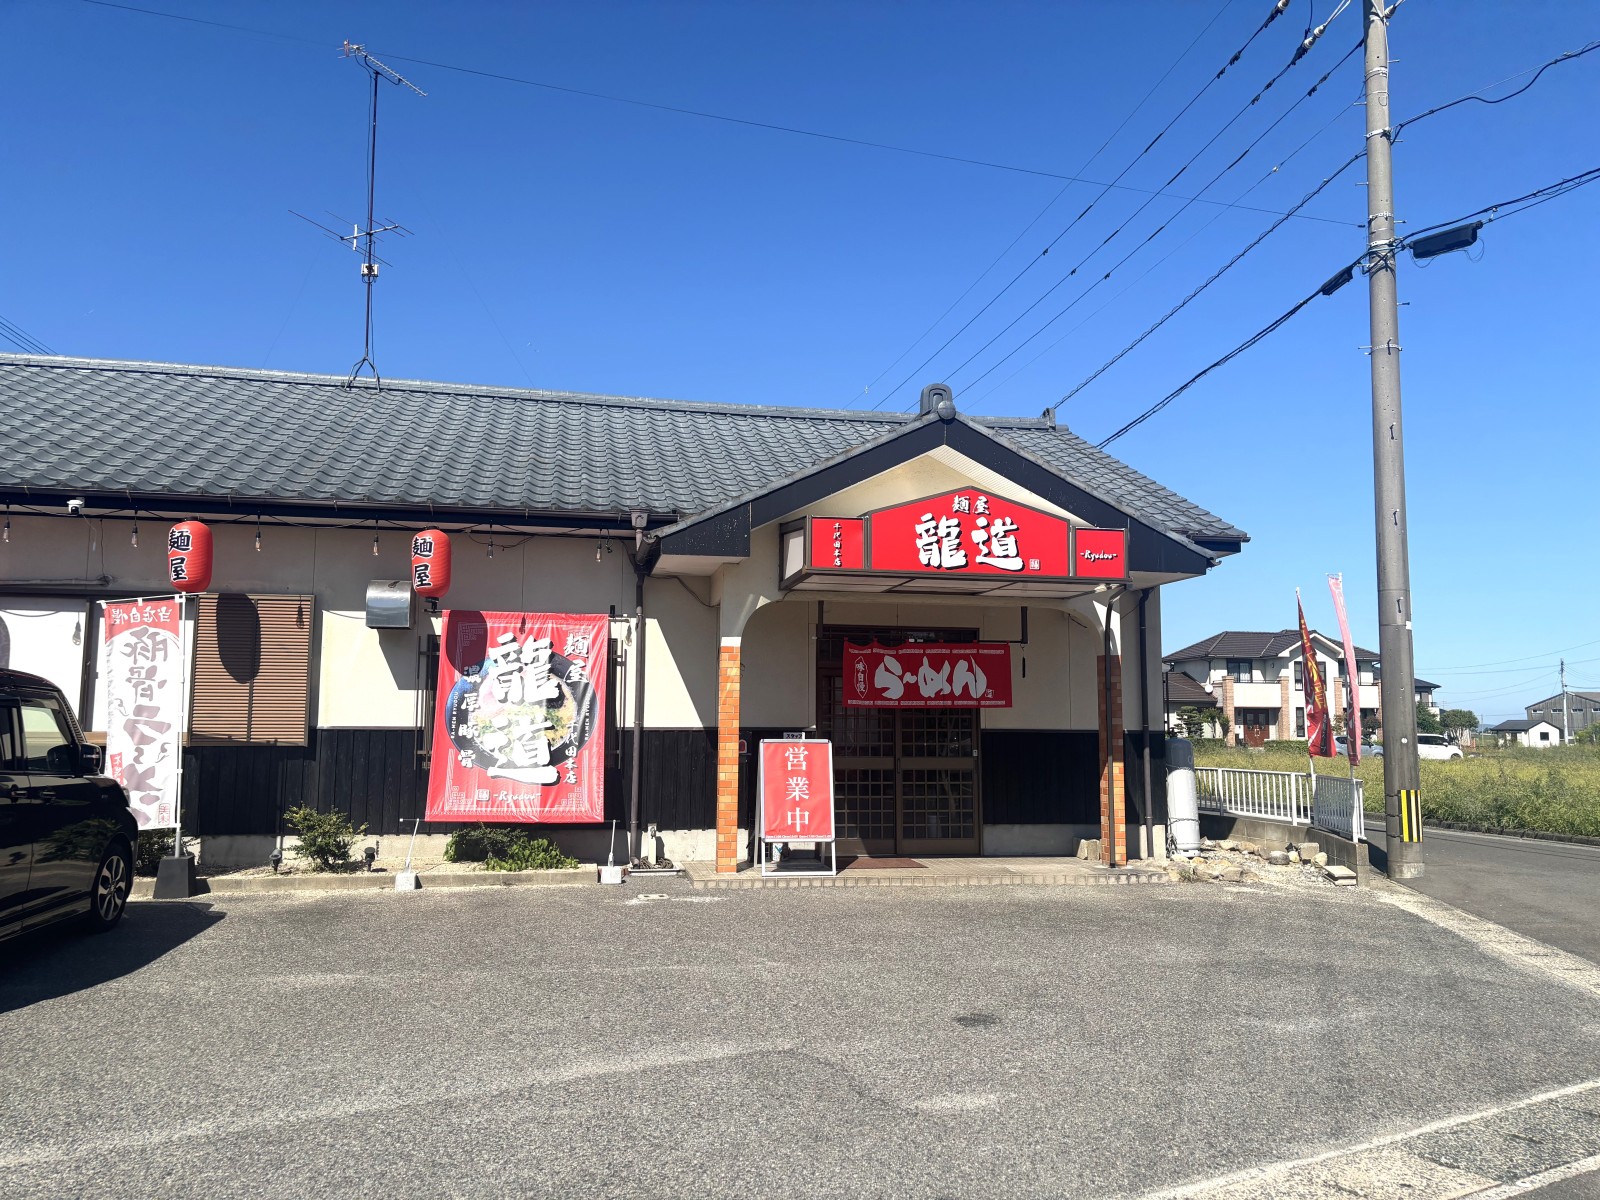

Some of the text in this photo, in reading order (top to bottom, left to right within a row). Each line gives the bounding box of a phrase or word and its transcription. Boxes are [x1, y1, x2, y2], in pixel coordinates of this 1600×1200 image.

[952, 495, 990, 514] 麺屋
[168, 527, 193, 582] 麺屋
[412, 536, 434, 590] 麺屋
[833, 522, 842, 566] 千代田本店
[914, 513, 1025, 571] 龍道
[563, 633, 590, 683] 麺屋
[484, 632, 560, 785] 龍道
[785, 747, 810, 832] 営業中
